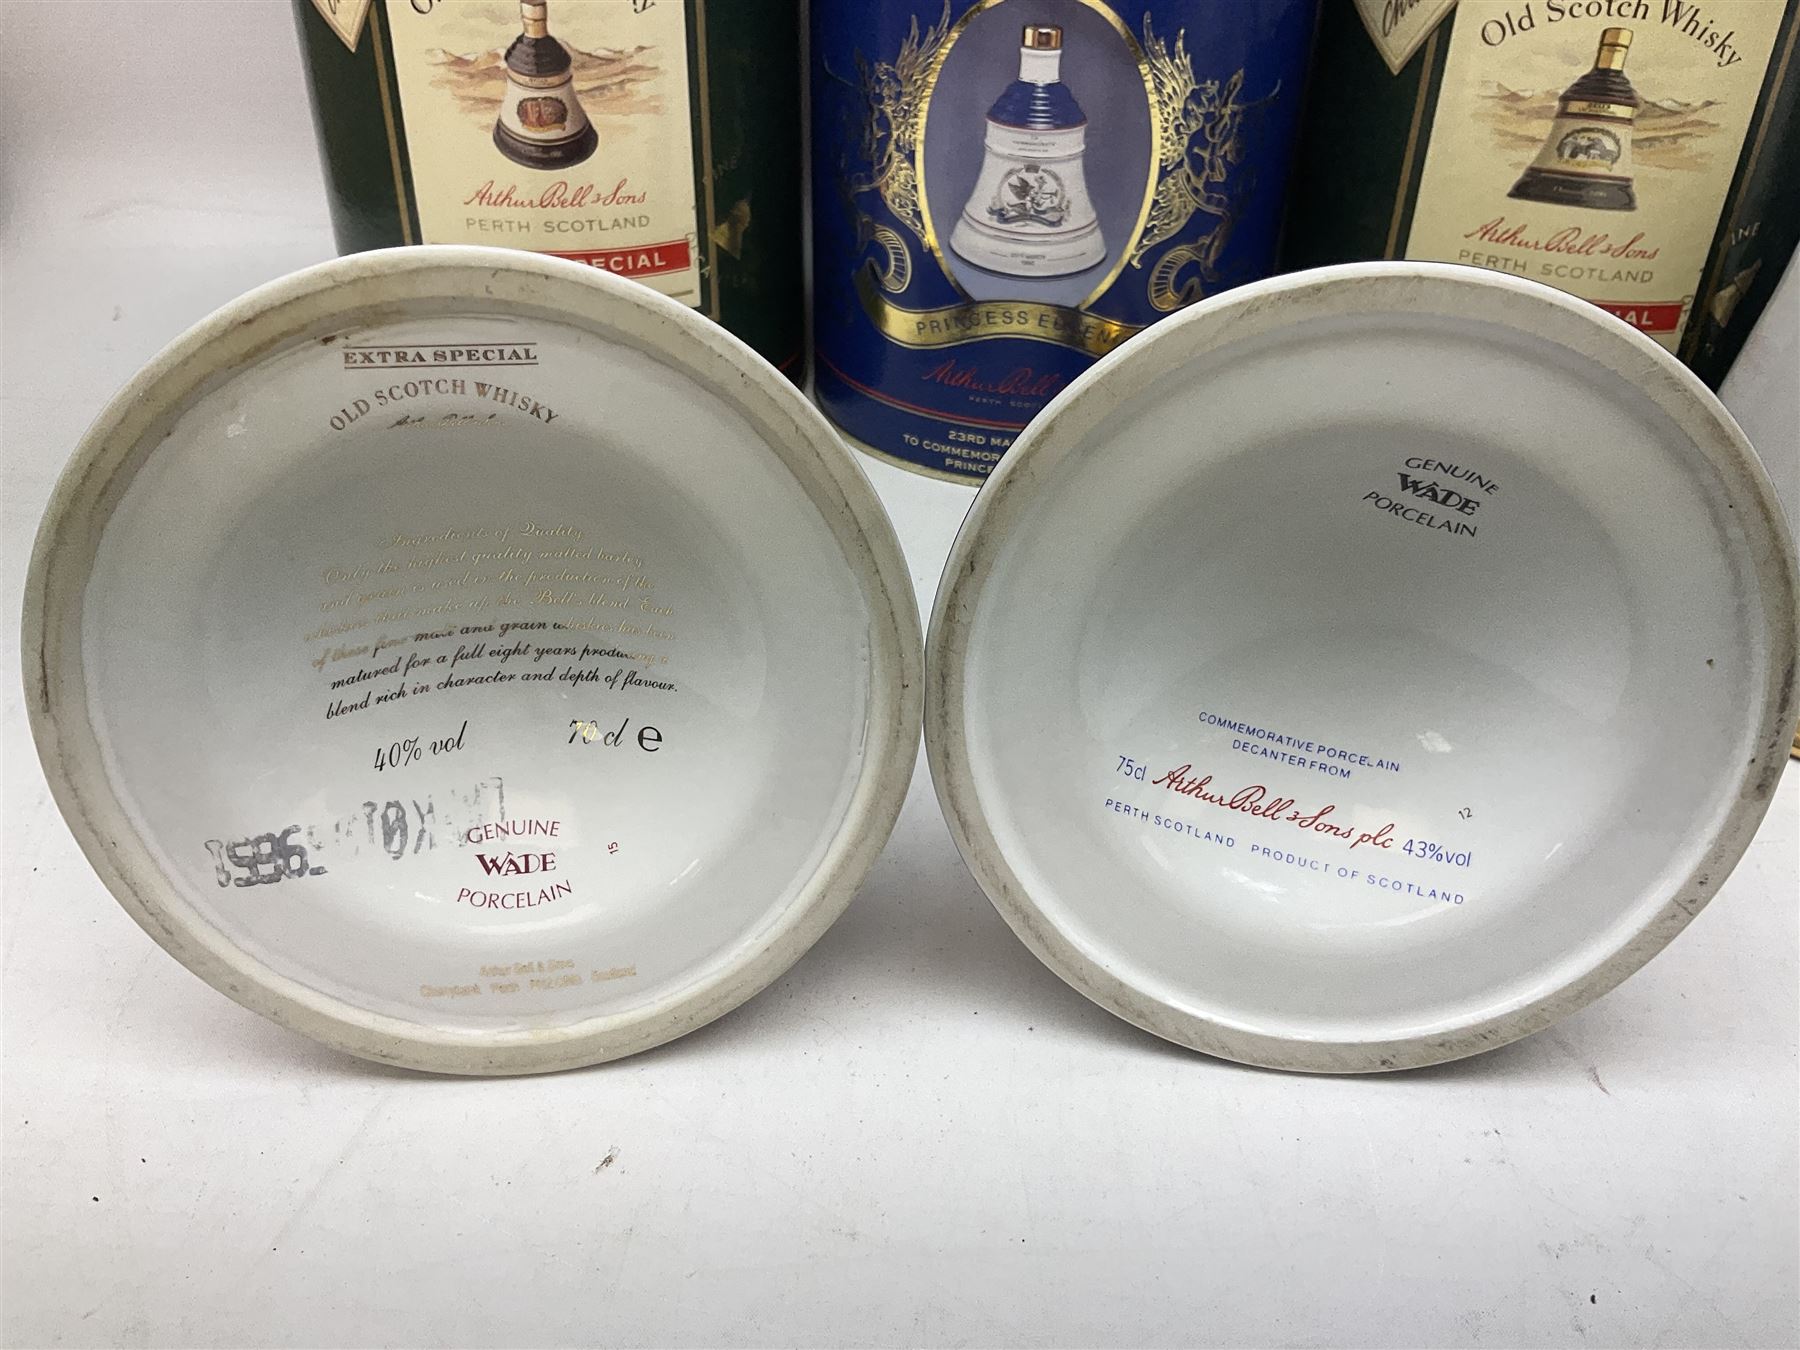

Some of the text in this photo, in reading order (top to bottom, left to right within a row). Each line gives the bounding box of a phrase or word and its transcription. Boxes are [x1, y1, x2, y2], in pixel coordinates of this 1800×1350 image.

[1481, 0, 1742, 67] Old Scotch Whisky
[464, 180, 540, 208] Arthur
[539, 181, 594, 209] Bell
[600, 178, 647, 207] Sons
[466, 215, 650, 233] PERTH SCOTLAND
[1464, 217, 1545, 250] Arthur
[1544, 227, 1608, 256] Bell
[1610, 232, 1660, 260] Sons
[575, 252, 666, 272] ECIAL
[1458, 250, 1653, 283] PERTH SCOTLAND
[916, 311, 1028, 336] PRINCESS
[344, 347, 538, 365] EXTRA SPECIAL
[329, 398, 371, 431] OLD
[374, 379, 466, 407] SCOTCH
[473, 381, 559, 425] WHISKY
[902, 433, 919, 446] TO
[948, 430, 986, 445] 23RD
[1405, 457, 1499, 495] GENUINE
[1397, 472, 1480, 516] WADE
[1362, 491, 1477, 537] PORCELAIN
[472, 547, 532, 565] quality
[525, 568, 611, 587] production
[499, 621, 548, 638] grain
[330, 656, 402, 690] matured
[403, 653, 432, 677] for
[436, 655, 449, 665] a
[450, 643, 486, 668] full
[488, 641, 531, 664] eight
[534, 646, 577, 663] years
[326, 666, 678, 719] blend rich in character and depth of flavour.
[373, 736, 422, 772] 40%
[429, 720, 468, 755] vol
[1198, 711, 1400, 772] COMMEMORATIVE PORCELAIN
[1232, 739, 1351, 779] DECANTER FROM
[1116, 755, 1147, 781] 75cl
[1152, 764, 1231, 807] Arthur
[1229, 785, 1295, 821] Bell
[1298, 805, 1354, 839] Sons
[1349, 823, 1395, 849] plc
[1458, 807, 1473, 820] 12
[467, 819, 561, 844] GENUINE
[475, 851, 557, 876] WADE
[607, 841, 620, 855] 15
[1105, 798, 1464, 905] PERTH SCOTLAND PRODUCT OF SCOTLAND
[457, 879, 573, 910] PORCELAIN
